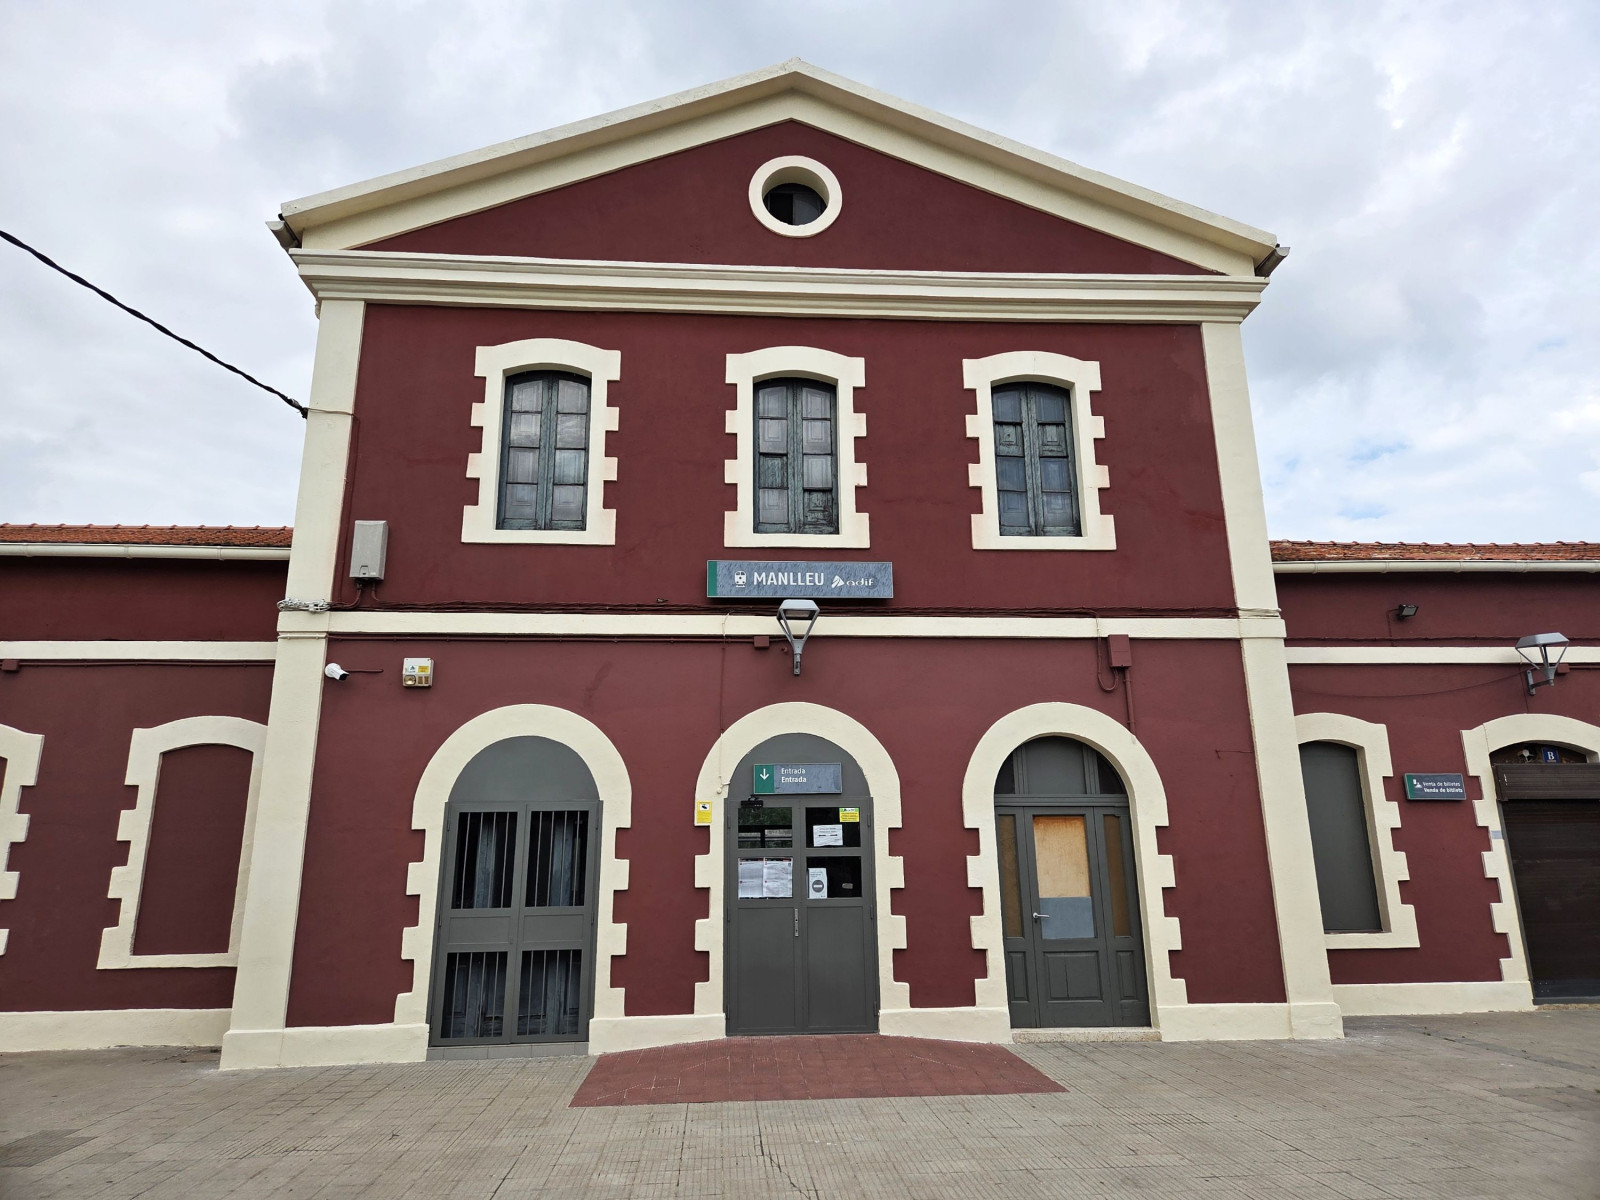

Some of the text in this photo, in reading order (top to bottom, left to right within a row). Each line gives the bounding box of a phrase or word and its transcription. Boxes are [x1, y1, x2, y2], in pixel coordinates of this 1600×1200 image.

[753, 572, 824, 586] MANLLEU
[846, 577, 874, 587] adif
[781, 767, 806, 775] Entrada
[781, 776, 807, 784] Entrada
